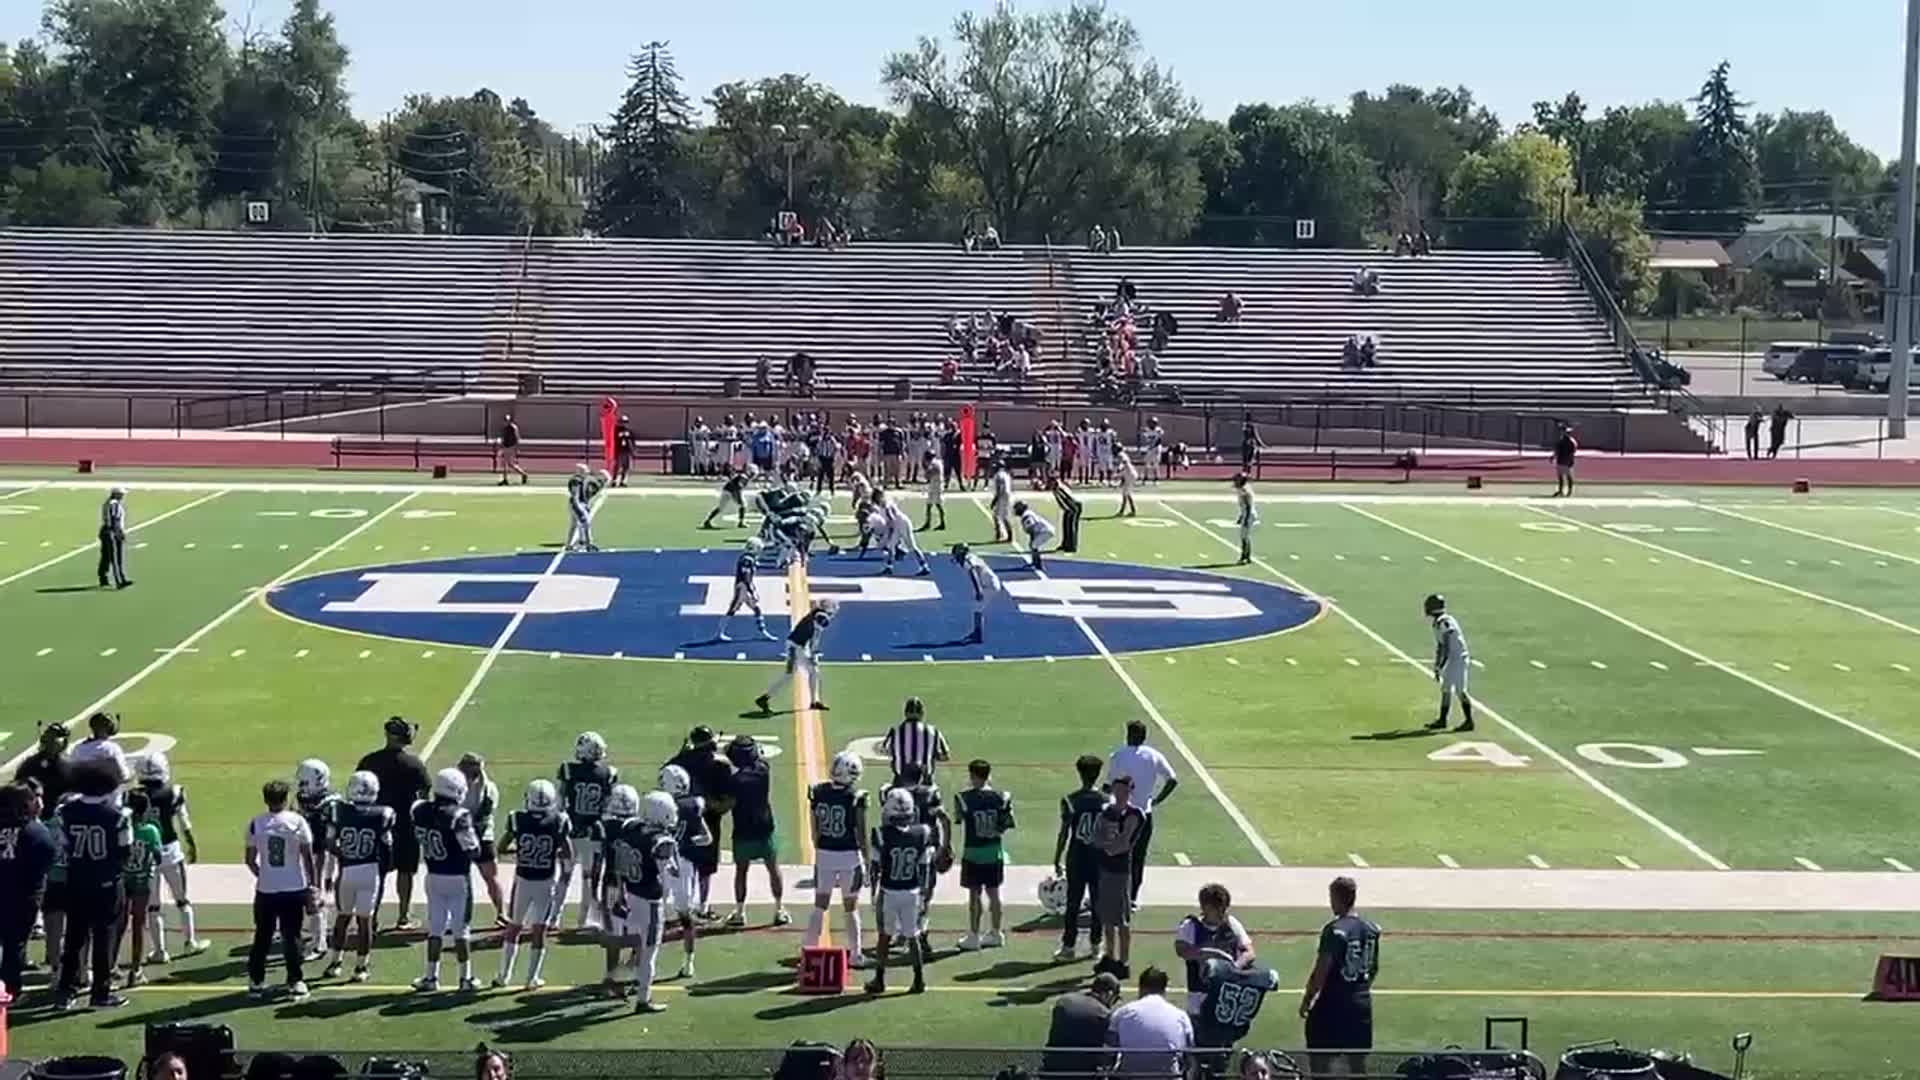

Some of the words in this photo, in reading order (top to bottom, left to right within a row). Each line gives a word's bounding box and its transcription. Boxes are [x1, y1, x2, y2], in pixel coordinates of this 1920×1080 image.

[1426, 741, 1690, 770] 40
[69, 824, 108, 861] 70
[518, 832, 554, 869] 22
[803, 951, 840, 988] 50
[1214, 981, 1260, 1027] 52
